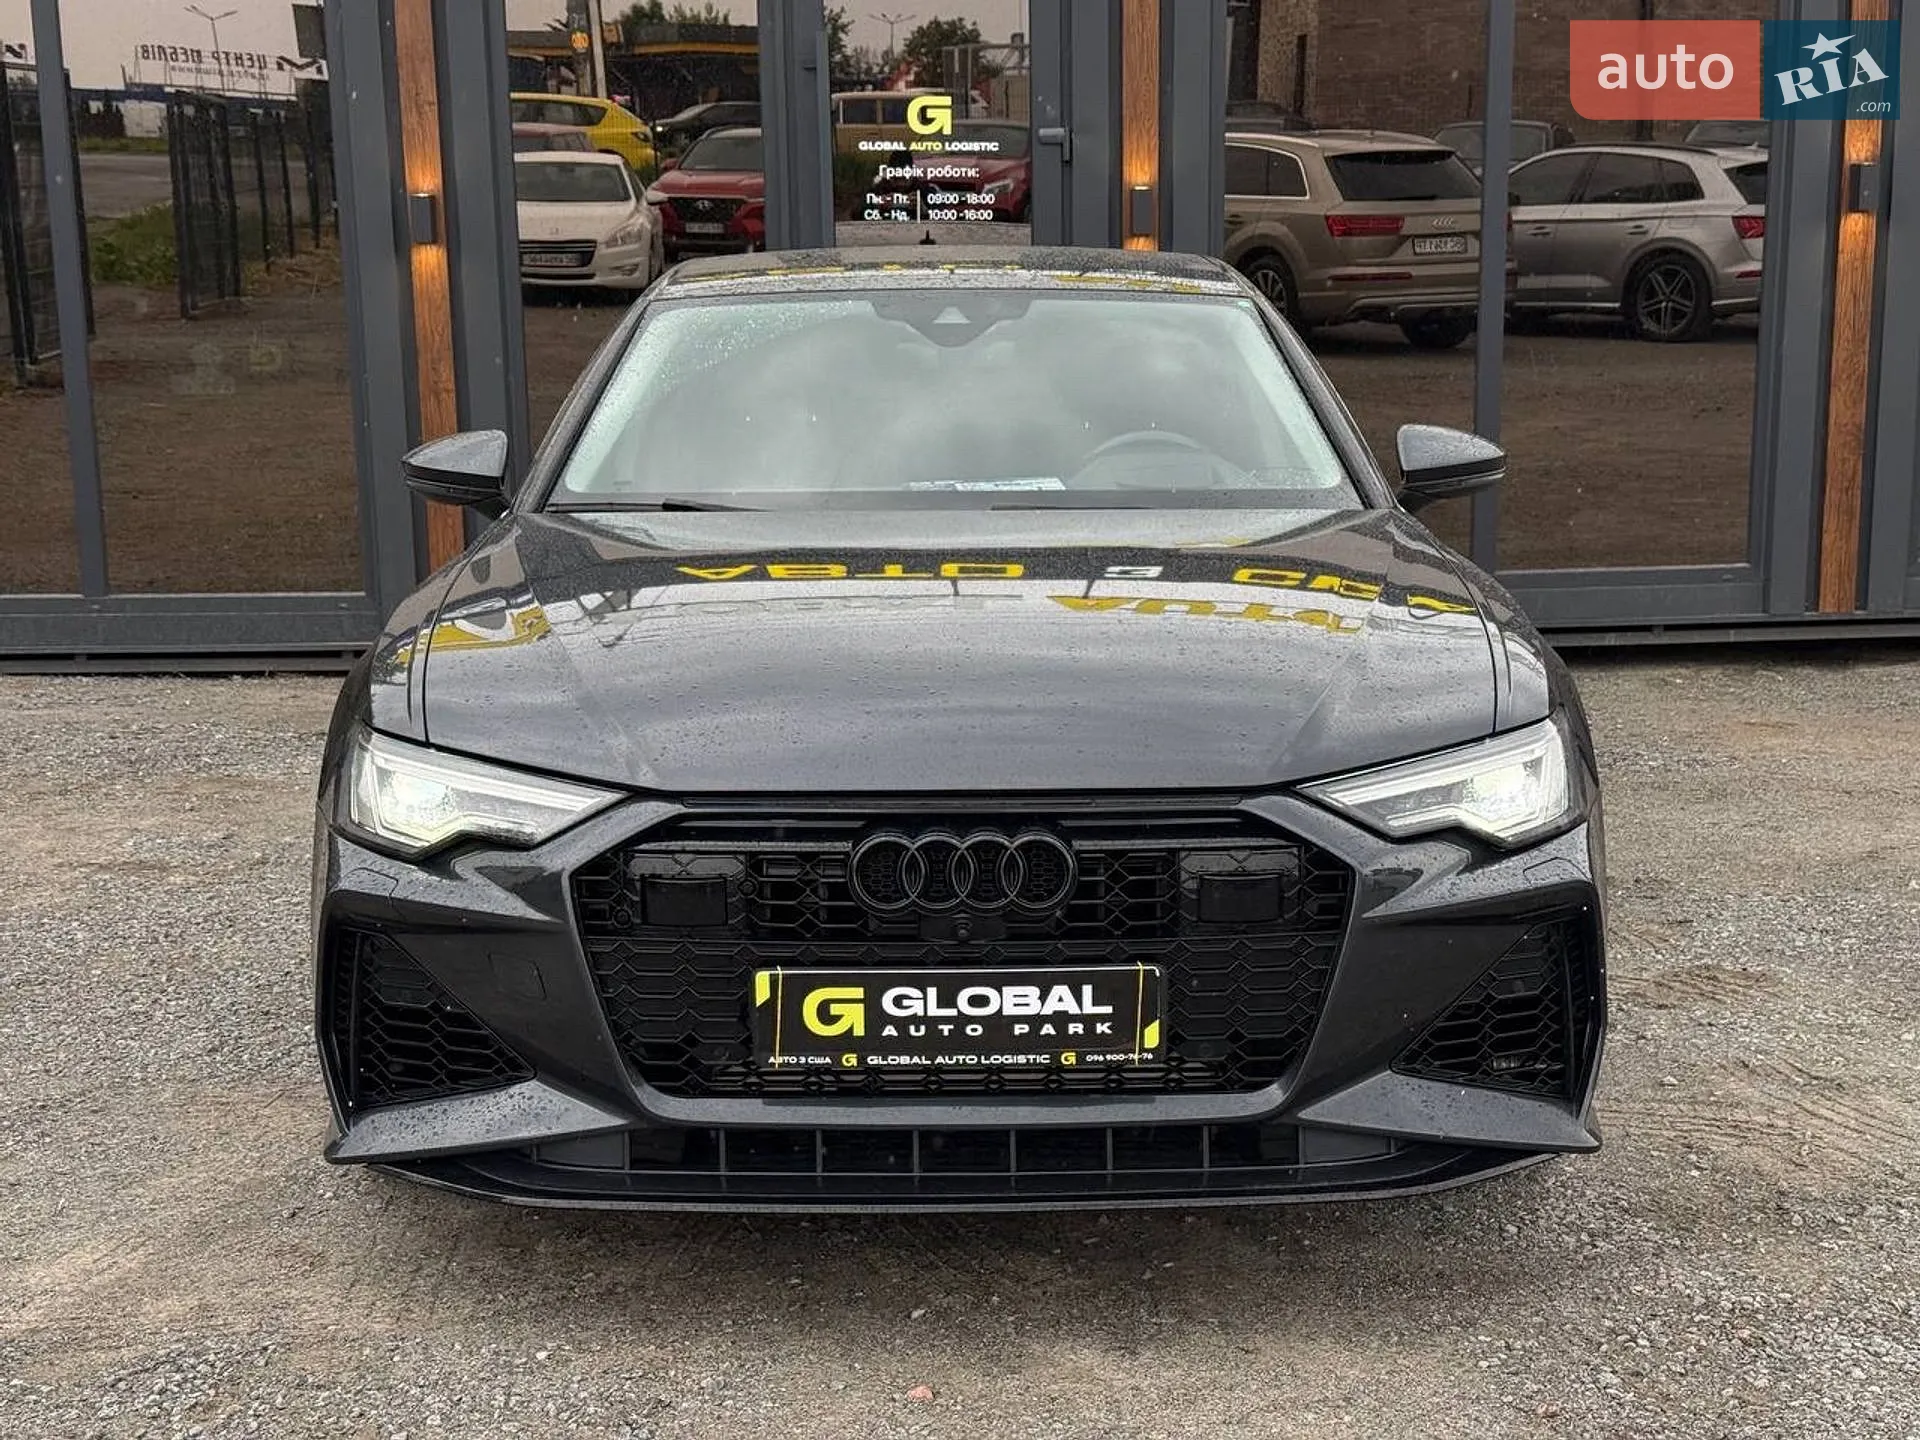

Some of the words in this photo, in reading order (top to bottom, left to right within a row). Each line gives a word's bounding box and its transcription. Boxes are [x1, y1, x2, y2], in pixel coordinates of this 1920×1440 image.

[858, 140, 907, 151] GLOBAL
[909, 140, 943, 151] AUTO
[945, 140, 1000, 151] LOGISTIC
[878, 164, 924, 180] Графік
[927, 164, 981, 180] роботи:
[927, 193, 959, 205] 09:00
[927, 209, 958, 221] 10:00
[881, 984, 1113, 1018] GLOBAL
[881, 1024, 984, 1037] AUTO
[1013, 1022, 1113, 1036] PARK
[867, 1055, 932, 1065] GLOBAL
[934, 1054, 978, 1065] AUTO
[980, 1054, 1051, 1065] LOGISTIC
